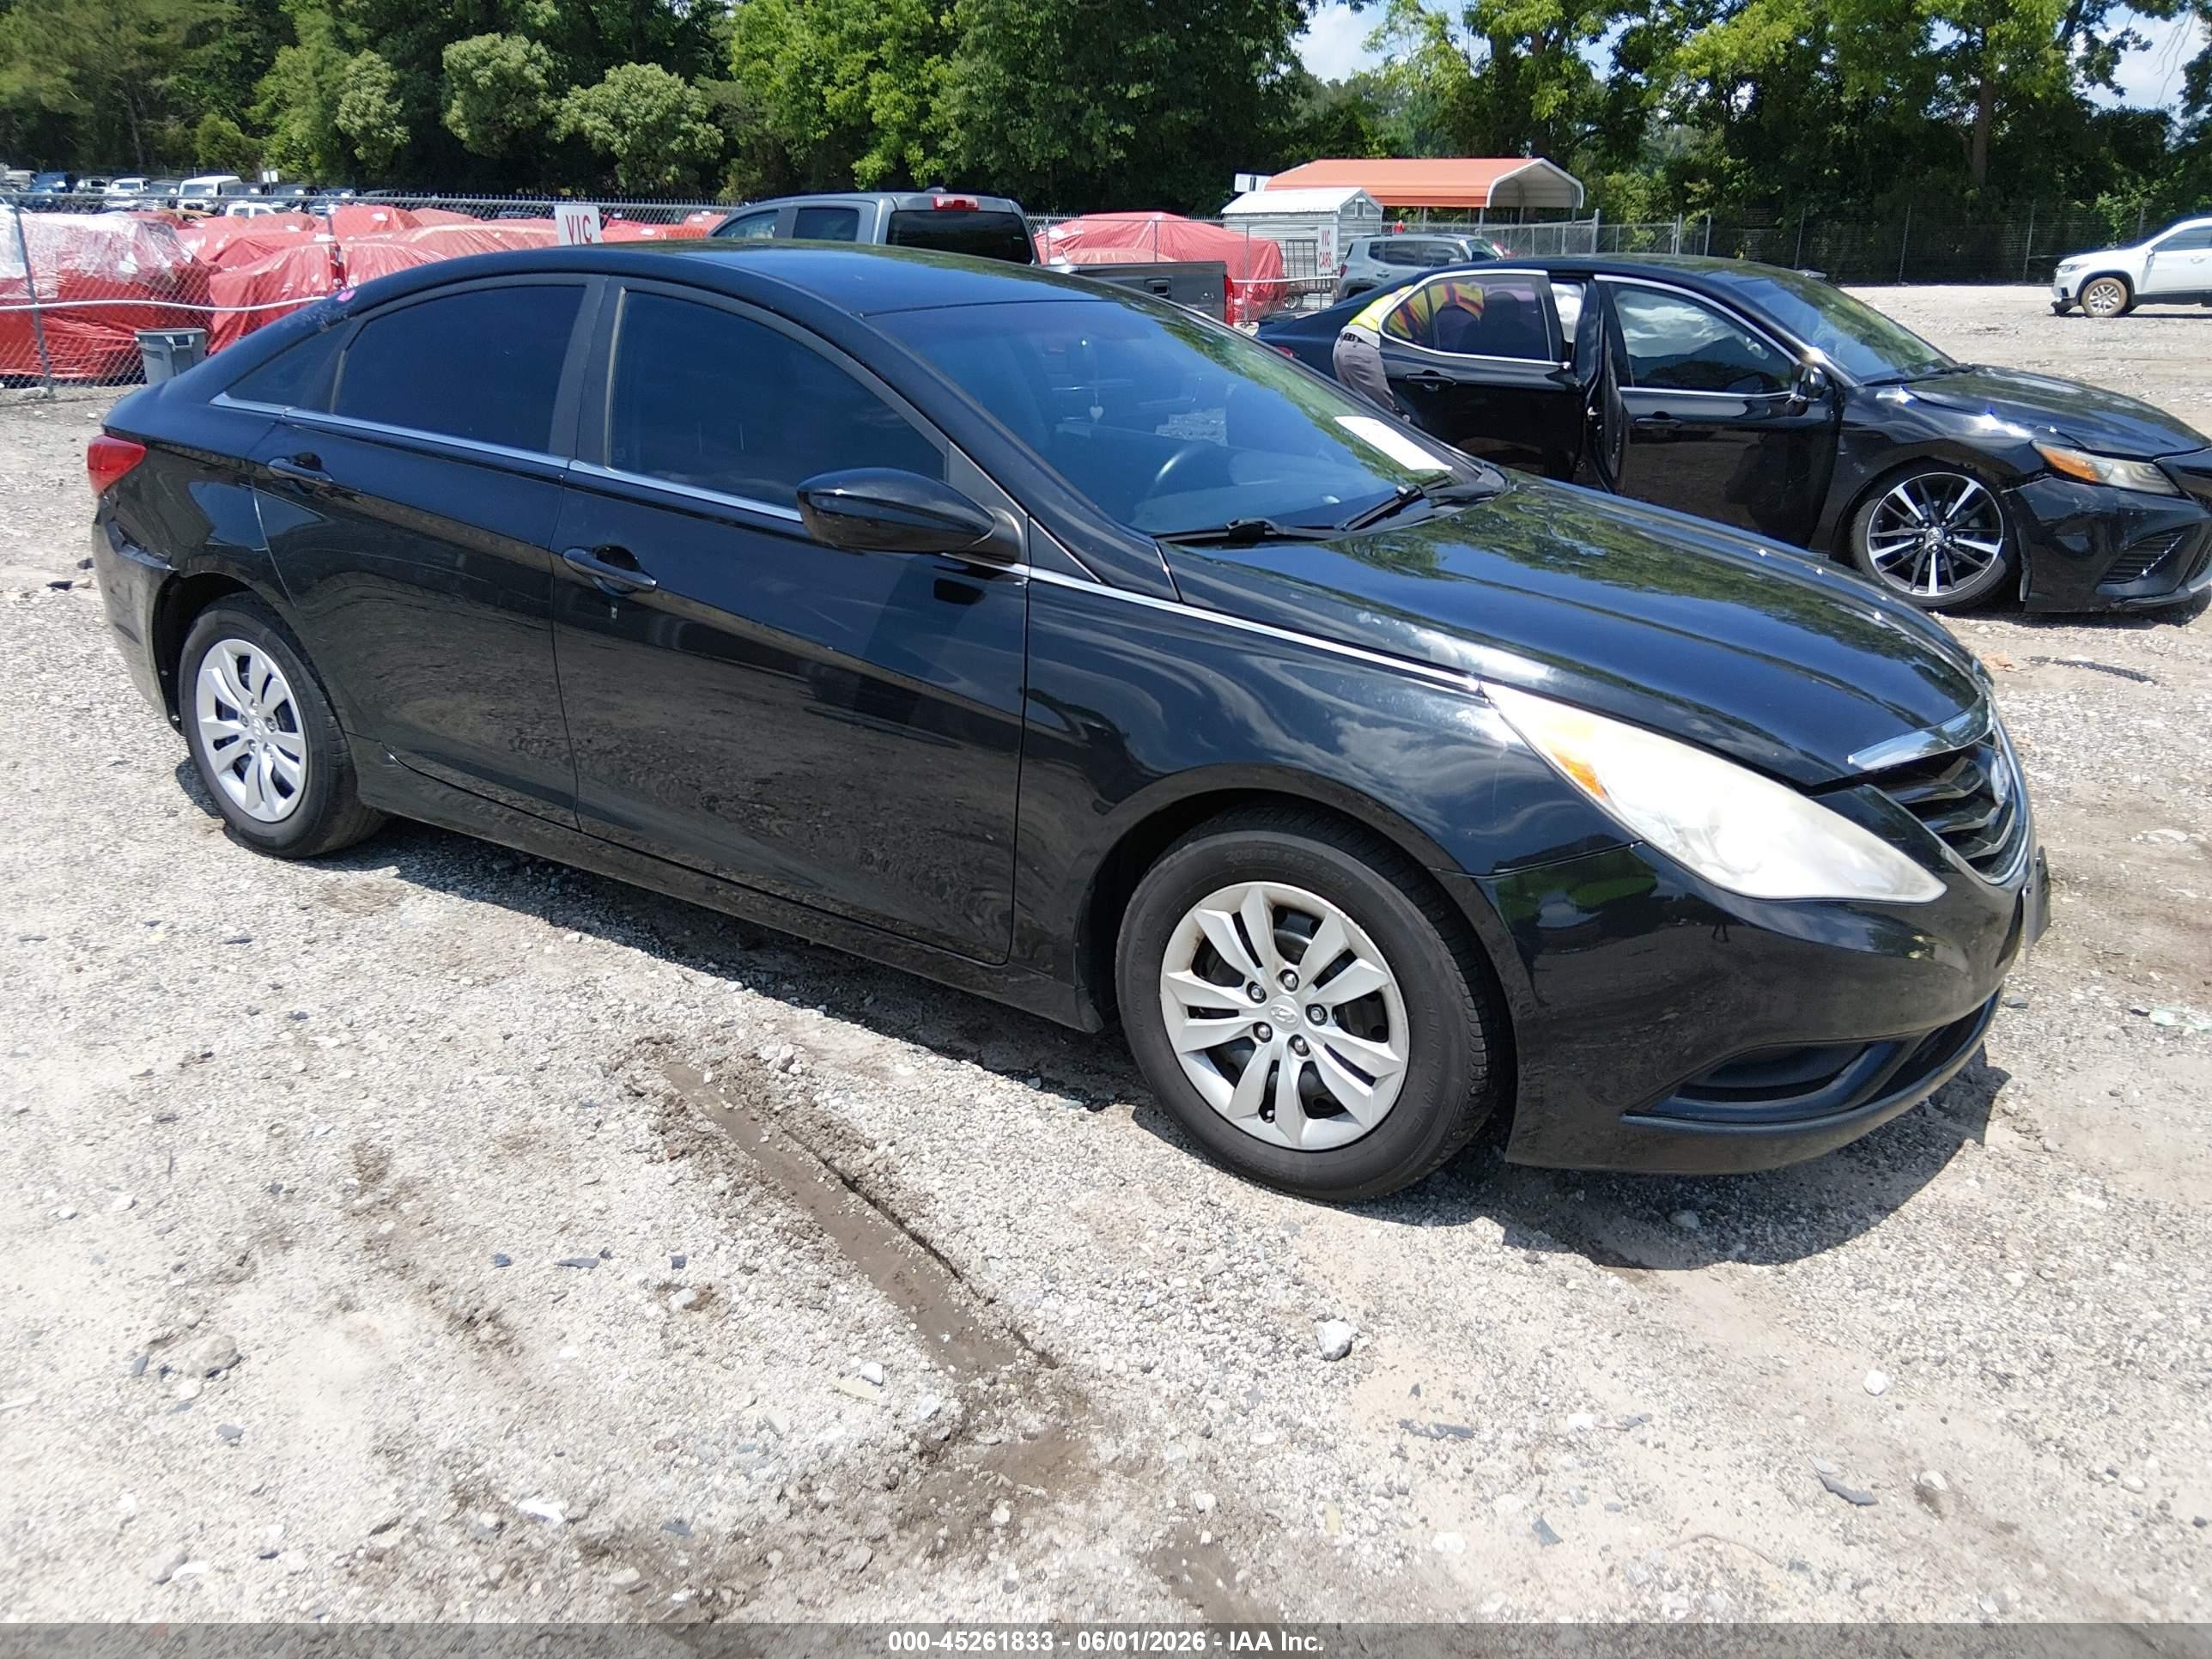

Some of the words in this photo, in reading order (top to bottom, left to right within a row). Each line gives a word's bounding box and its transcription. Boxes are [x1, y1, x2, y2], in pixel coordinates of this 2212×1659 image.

[565, 214, 592, 246] VIC
[1321, 228, 1331, 246] VIC
[1318, 251, 1332, 269] CARS
